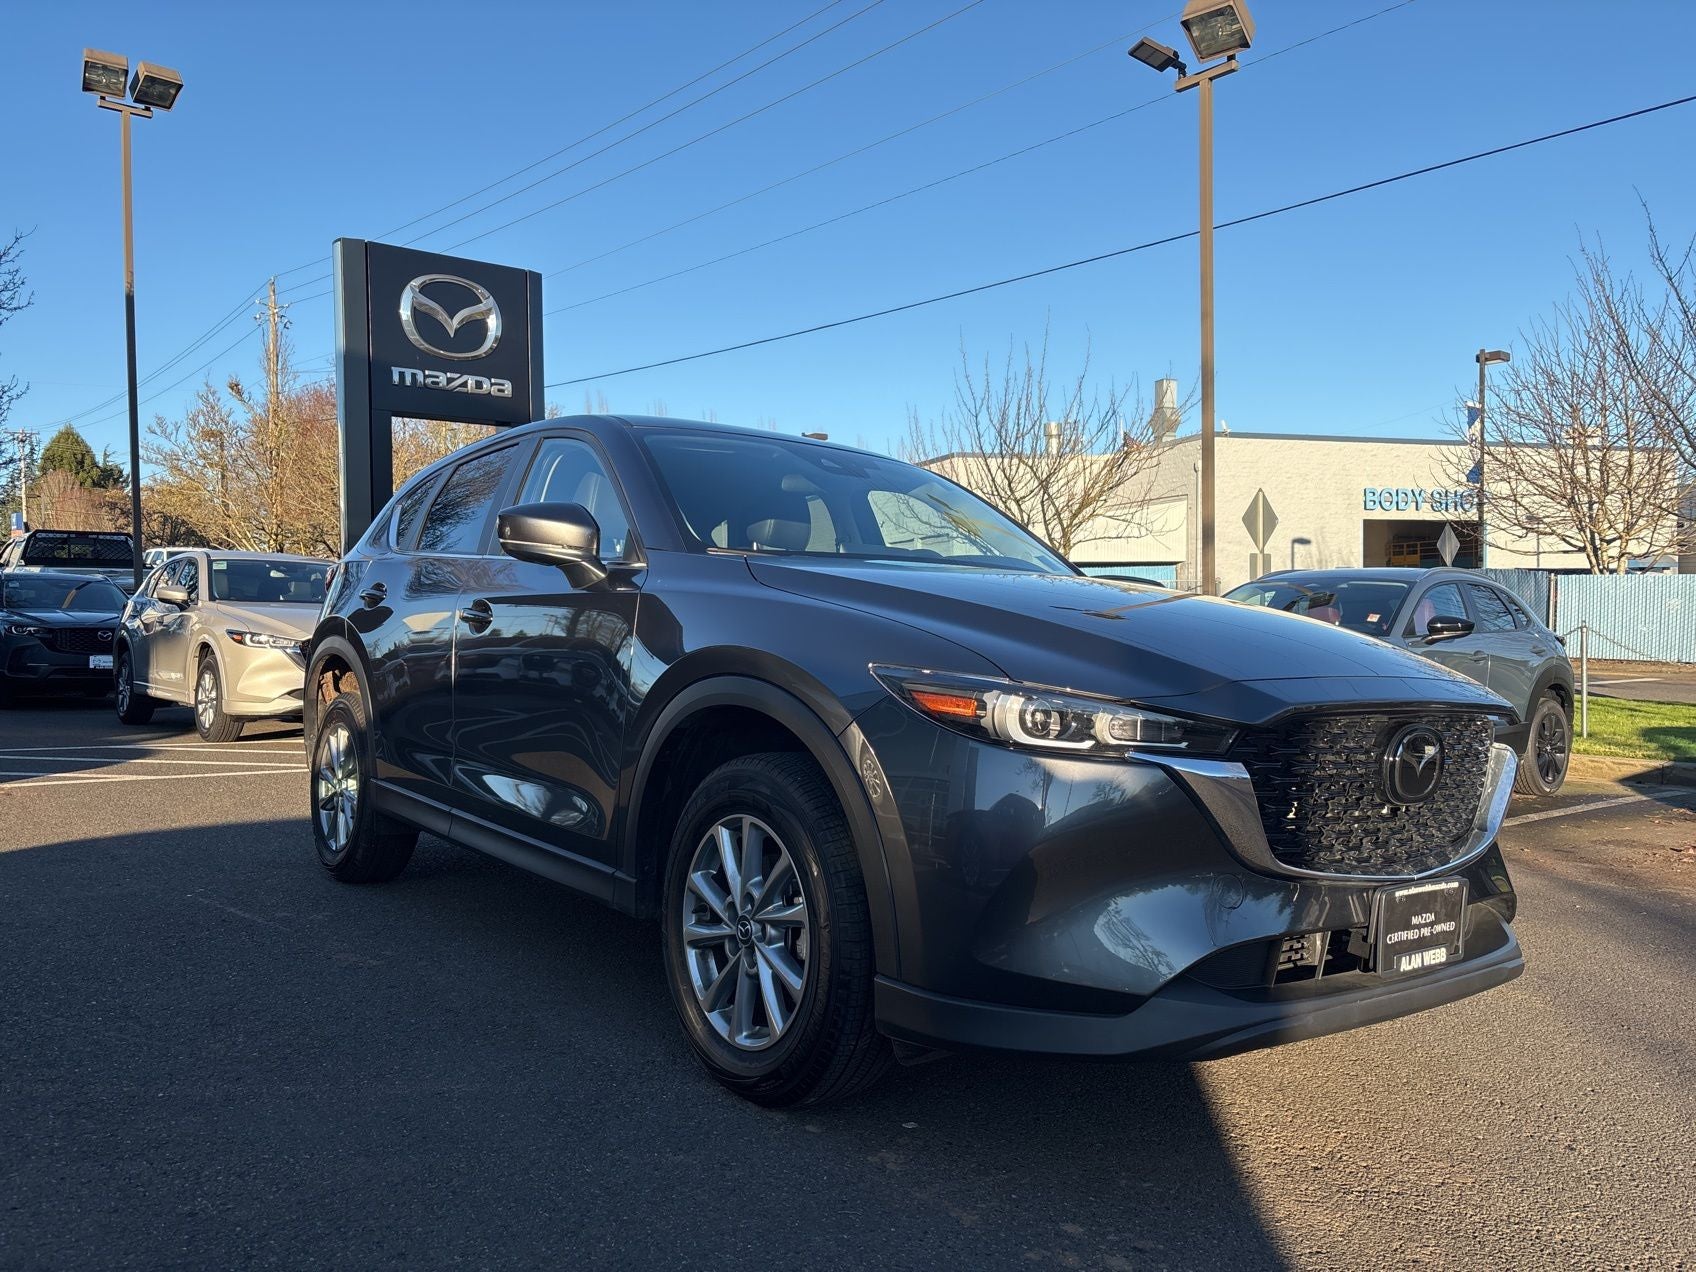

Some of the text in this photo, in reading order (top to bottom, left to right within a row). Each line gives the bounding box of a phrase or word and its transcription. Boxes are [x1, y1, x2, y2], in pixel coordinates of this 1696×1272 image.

[1364, 488, 1485, 512] BODY SHO
[1411, 912, 1435, 925] MAZDA
[1386, 921, 1456, 944] CERTIFIED PRE-OWNED
[1400, 947, 1447, 972] ALAN WEBB
